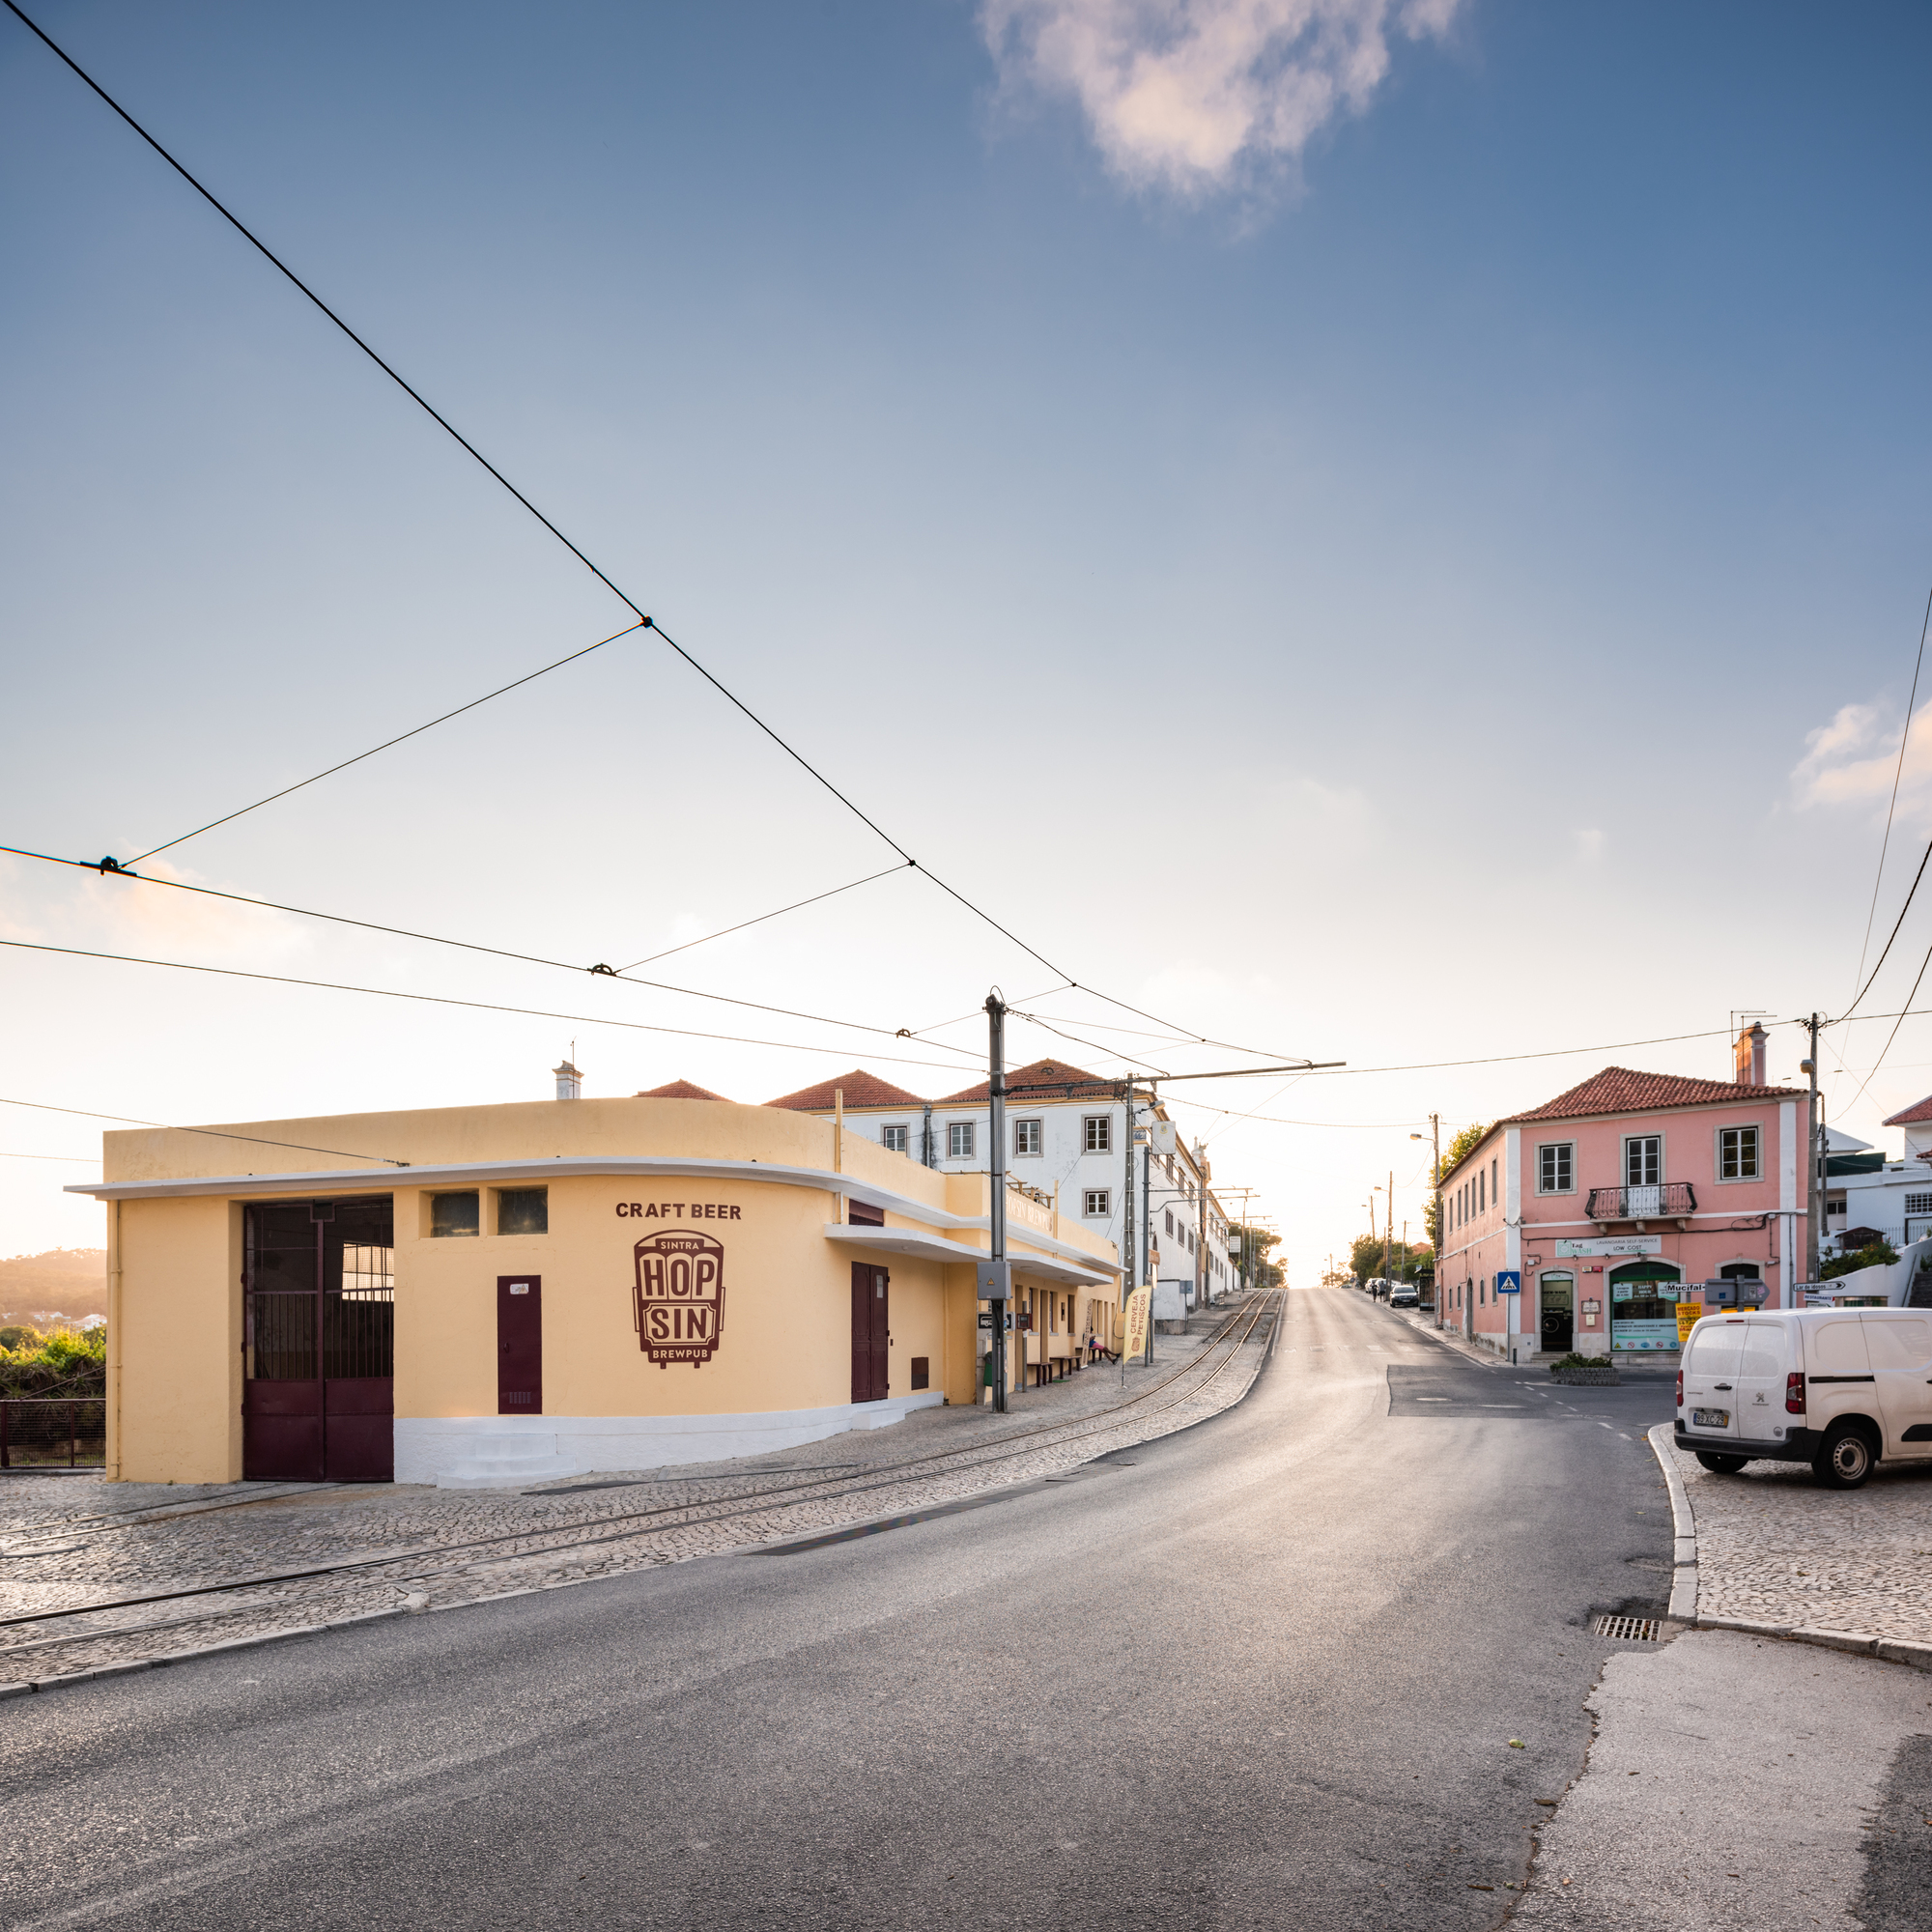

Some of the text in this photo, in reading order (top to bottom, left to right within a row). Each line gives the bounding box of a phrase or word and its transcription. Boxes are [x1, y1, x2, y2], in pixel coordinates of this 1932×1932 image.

[615, 1203, 742, 1220] CRAFT BEER
[661, 1241, 699, 1250] SINTRA
[643, 1259, 715, 1296] HOP
[651, 1308, 707, 1339] SIN
[1130, 1294, 1139, 1334] CERVEJA
[1137, 1293, 1147, 1335] PETISCOS
[652, 1350, 708, 1359] BREWPUB
